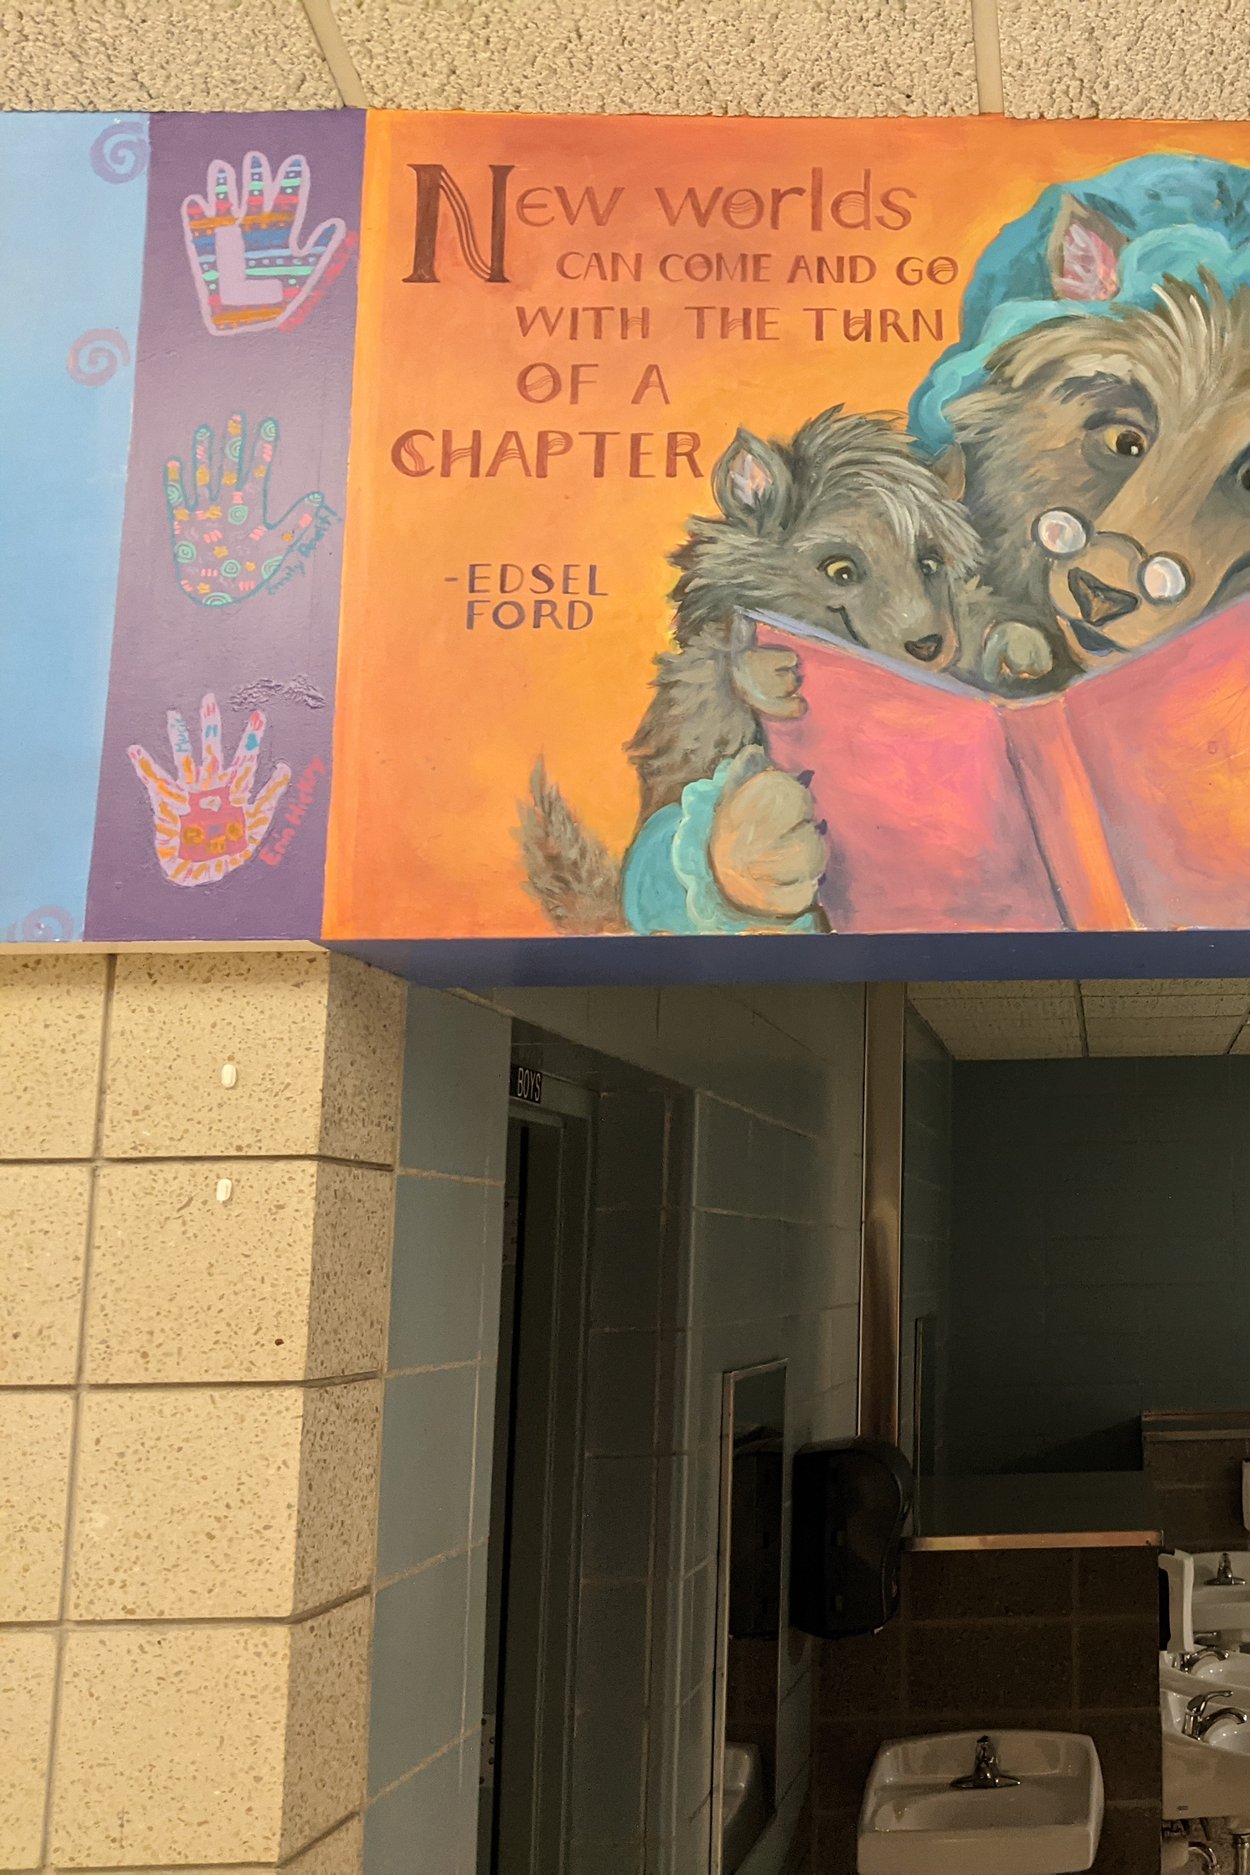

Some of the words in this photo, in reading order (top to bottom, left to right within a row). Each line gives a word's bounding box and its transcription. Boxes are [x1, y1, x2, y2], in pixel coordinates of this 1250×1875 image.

[556, 251, 643, 283] CAN
[659, 252, 773, 285] COME
[786, 254, 878, 286] AND
[896, 255, 960, 287] GO
[515, 305, 651, 342] WITH
[684, 305, 781, 342] THE
[803, 307, 945, 343] TURN
[516, 362, 600, 405] OF
[630, 363, 672, 405] A
[390, 429, 706, 480] CHAPTER
[466, 600, 595, 632] FORD
[517, 1067, 542, 1102] BOYS
